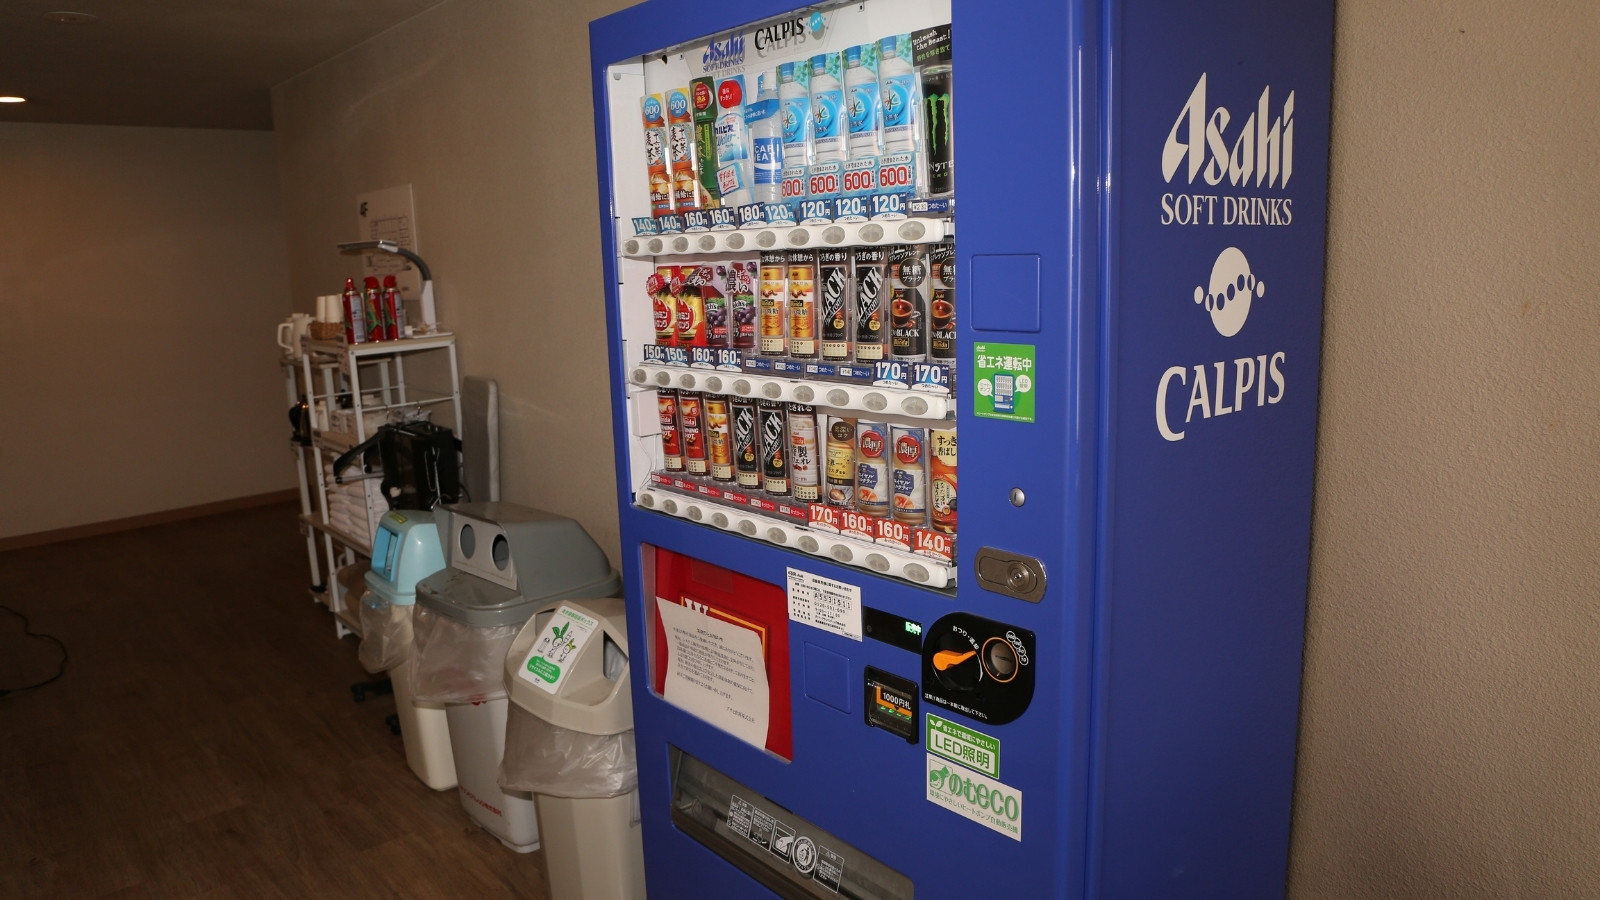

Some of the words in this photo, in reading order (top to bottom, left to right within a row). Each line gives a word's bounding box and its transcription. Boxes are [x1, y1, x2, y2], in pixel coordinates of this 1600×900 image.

[755, 17, 804, 50] CALPIS
[703, 31, 745, 64] Asahi
[720, 58, 743, 68] DRINKS
[645, 105, 659, 115] 600
[670, 100, 685, 110] 600
[1162, 72, 1294, 189] Asahi
[811, 175, 835, 194] 600
[844, 171, 870, 191] 600
[880, 166, 907, 187] 600
[781, 179, 801, 197] 600
[766, 205, 794, 220] 120円
[801, 200, 830, 218] 120円
[836, 198, 866, 215] 120円
[873, 194, 906, 213] 120円
[1161, 193, 1217, 225] SOFT
[1223, 196, 1292, 226] DRINKS
[659, 216, 680, 229] 140円
[685, 212, 707, 226] 160円
[709, 209, 734, 224] 160円
[739, 206, 764, 222] 180円
[634, 219, 656, 232] 140円
[943, 265, 955, 276] 無
[644, 345, 665, 359] 150円
[665, 347, 688, 361] 150円
[692, 347, 713, 362] 160円
[718, 350, 741, 365] 160円
[876, 361, 907, 380] 170円
[977, 354, 1032, 372] 省エネ運転中
[914, 364, 947, 383] 170円
[1155, 351, 1285, 442] CALPIS
[863, 438, 881, 452] 濃厚
[899, 442, 918, 457] 濃厚
[811, 505, 838, 525] 170円
[842, 512, 872, 532] 160円
[877, 520, 908, 542] 160円
[916, 531, 950, 554] 140円
[883, 692, 911, 710] 1000円札
[935, 734, 989, 769] LED照明
